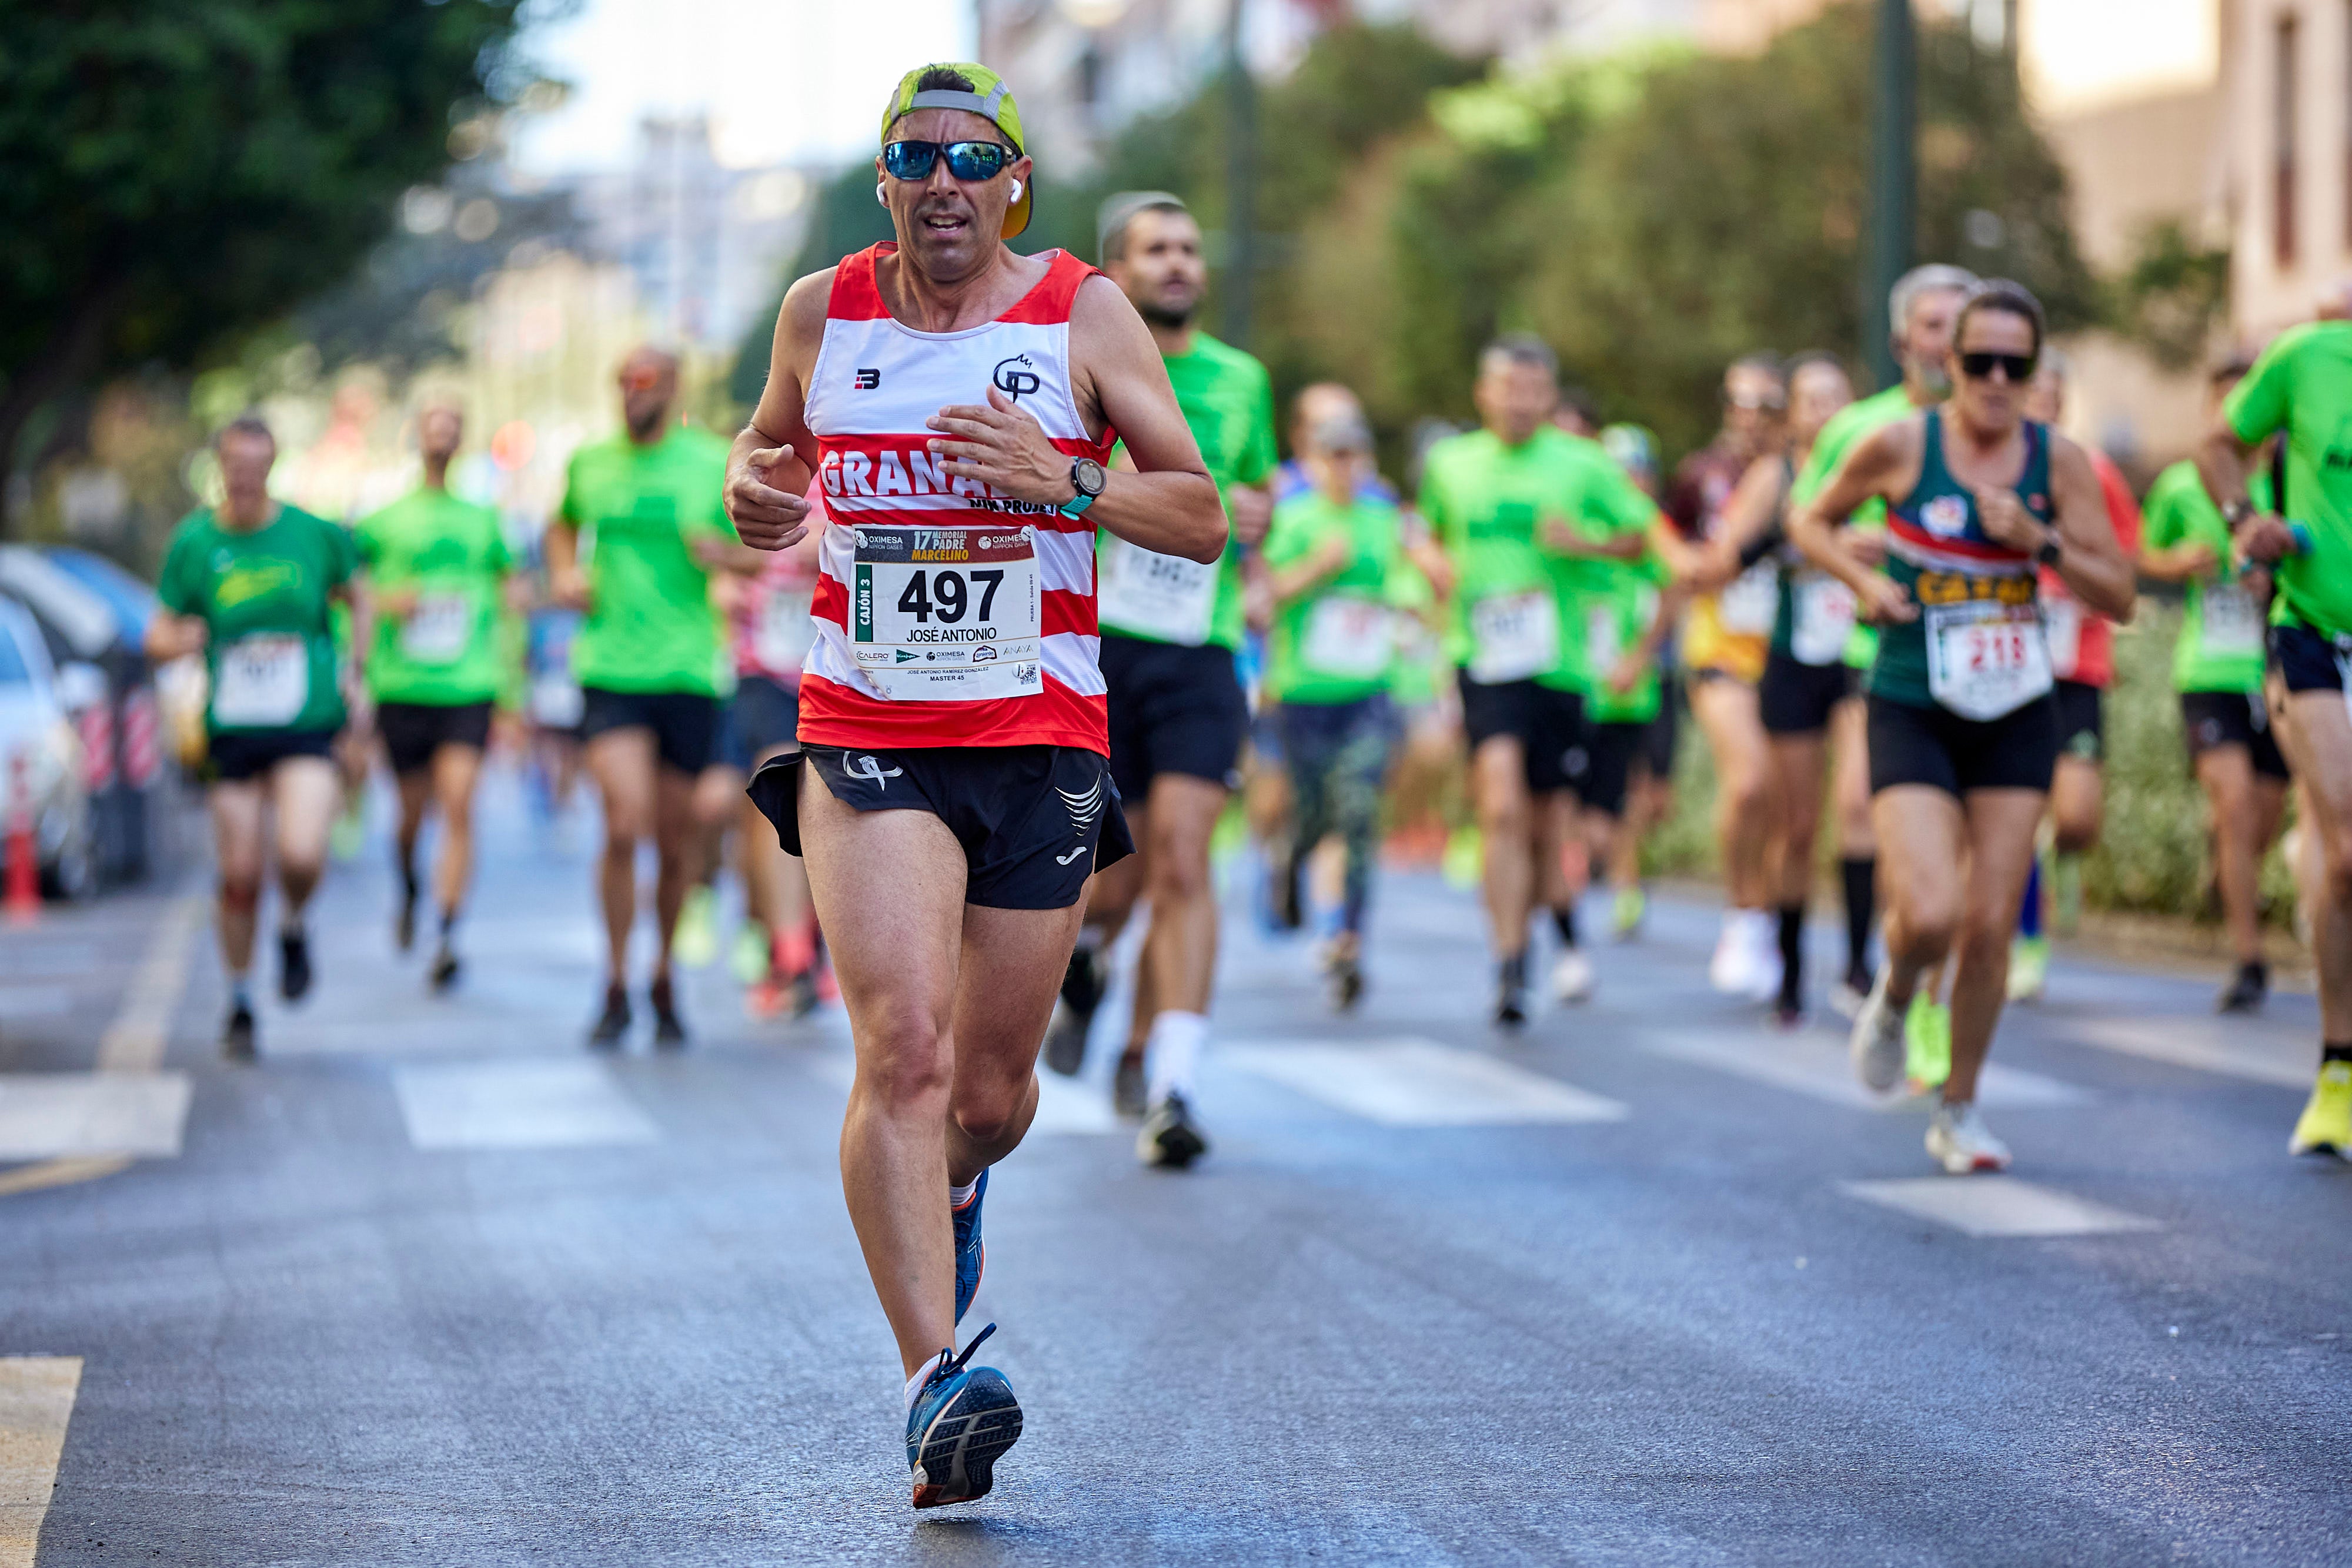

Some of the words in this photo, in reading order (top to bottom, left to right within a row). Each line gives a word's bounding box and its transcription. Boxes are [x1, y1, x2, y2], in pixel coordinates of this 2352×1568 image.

[820, 450, 1015, 498] GRANA
[868, 536, 903, 544] OXIMESA
[914, 531, 933, 550] 17
[932, 530, 967, 539] MEMORIAL
[933, 539, 965, 550] PADRE
[993, 534, 1022, 543] OXIMES
[911, 549, 969, 560] MARCELINO
[898, 569, 1004, 623] 497
[858, 590, 870, 626] CAJÓN
[907, 626, 939, 643] JOSÉ
[941, 627, 997, 642] ANTONIO
[1003, 644, 1034, 655] ANAYA
